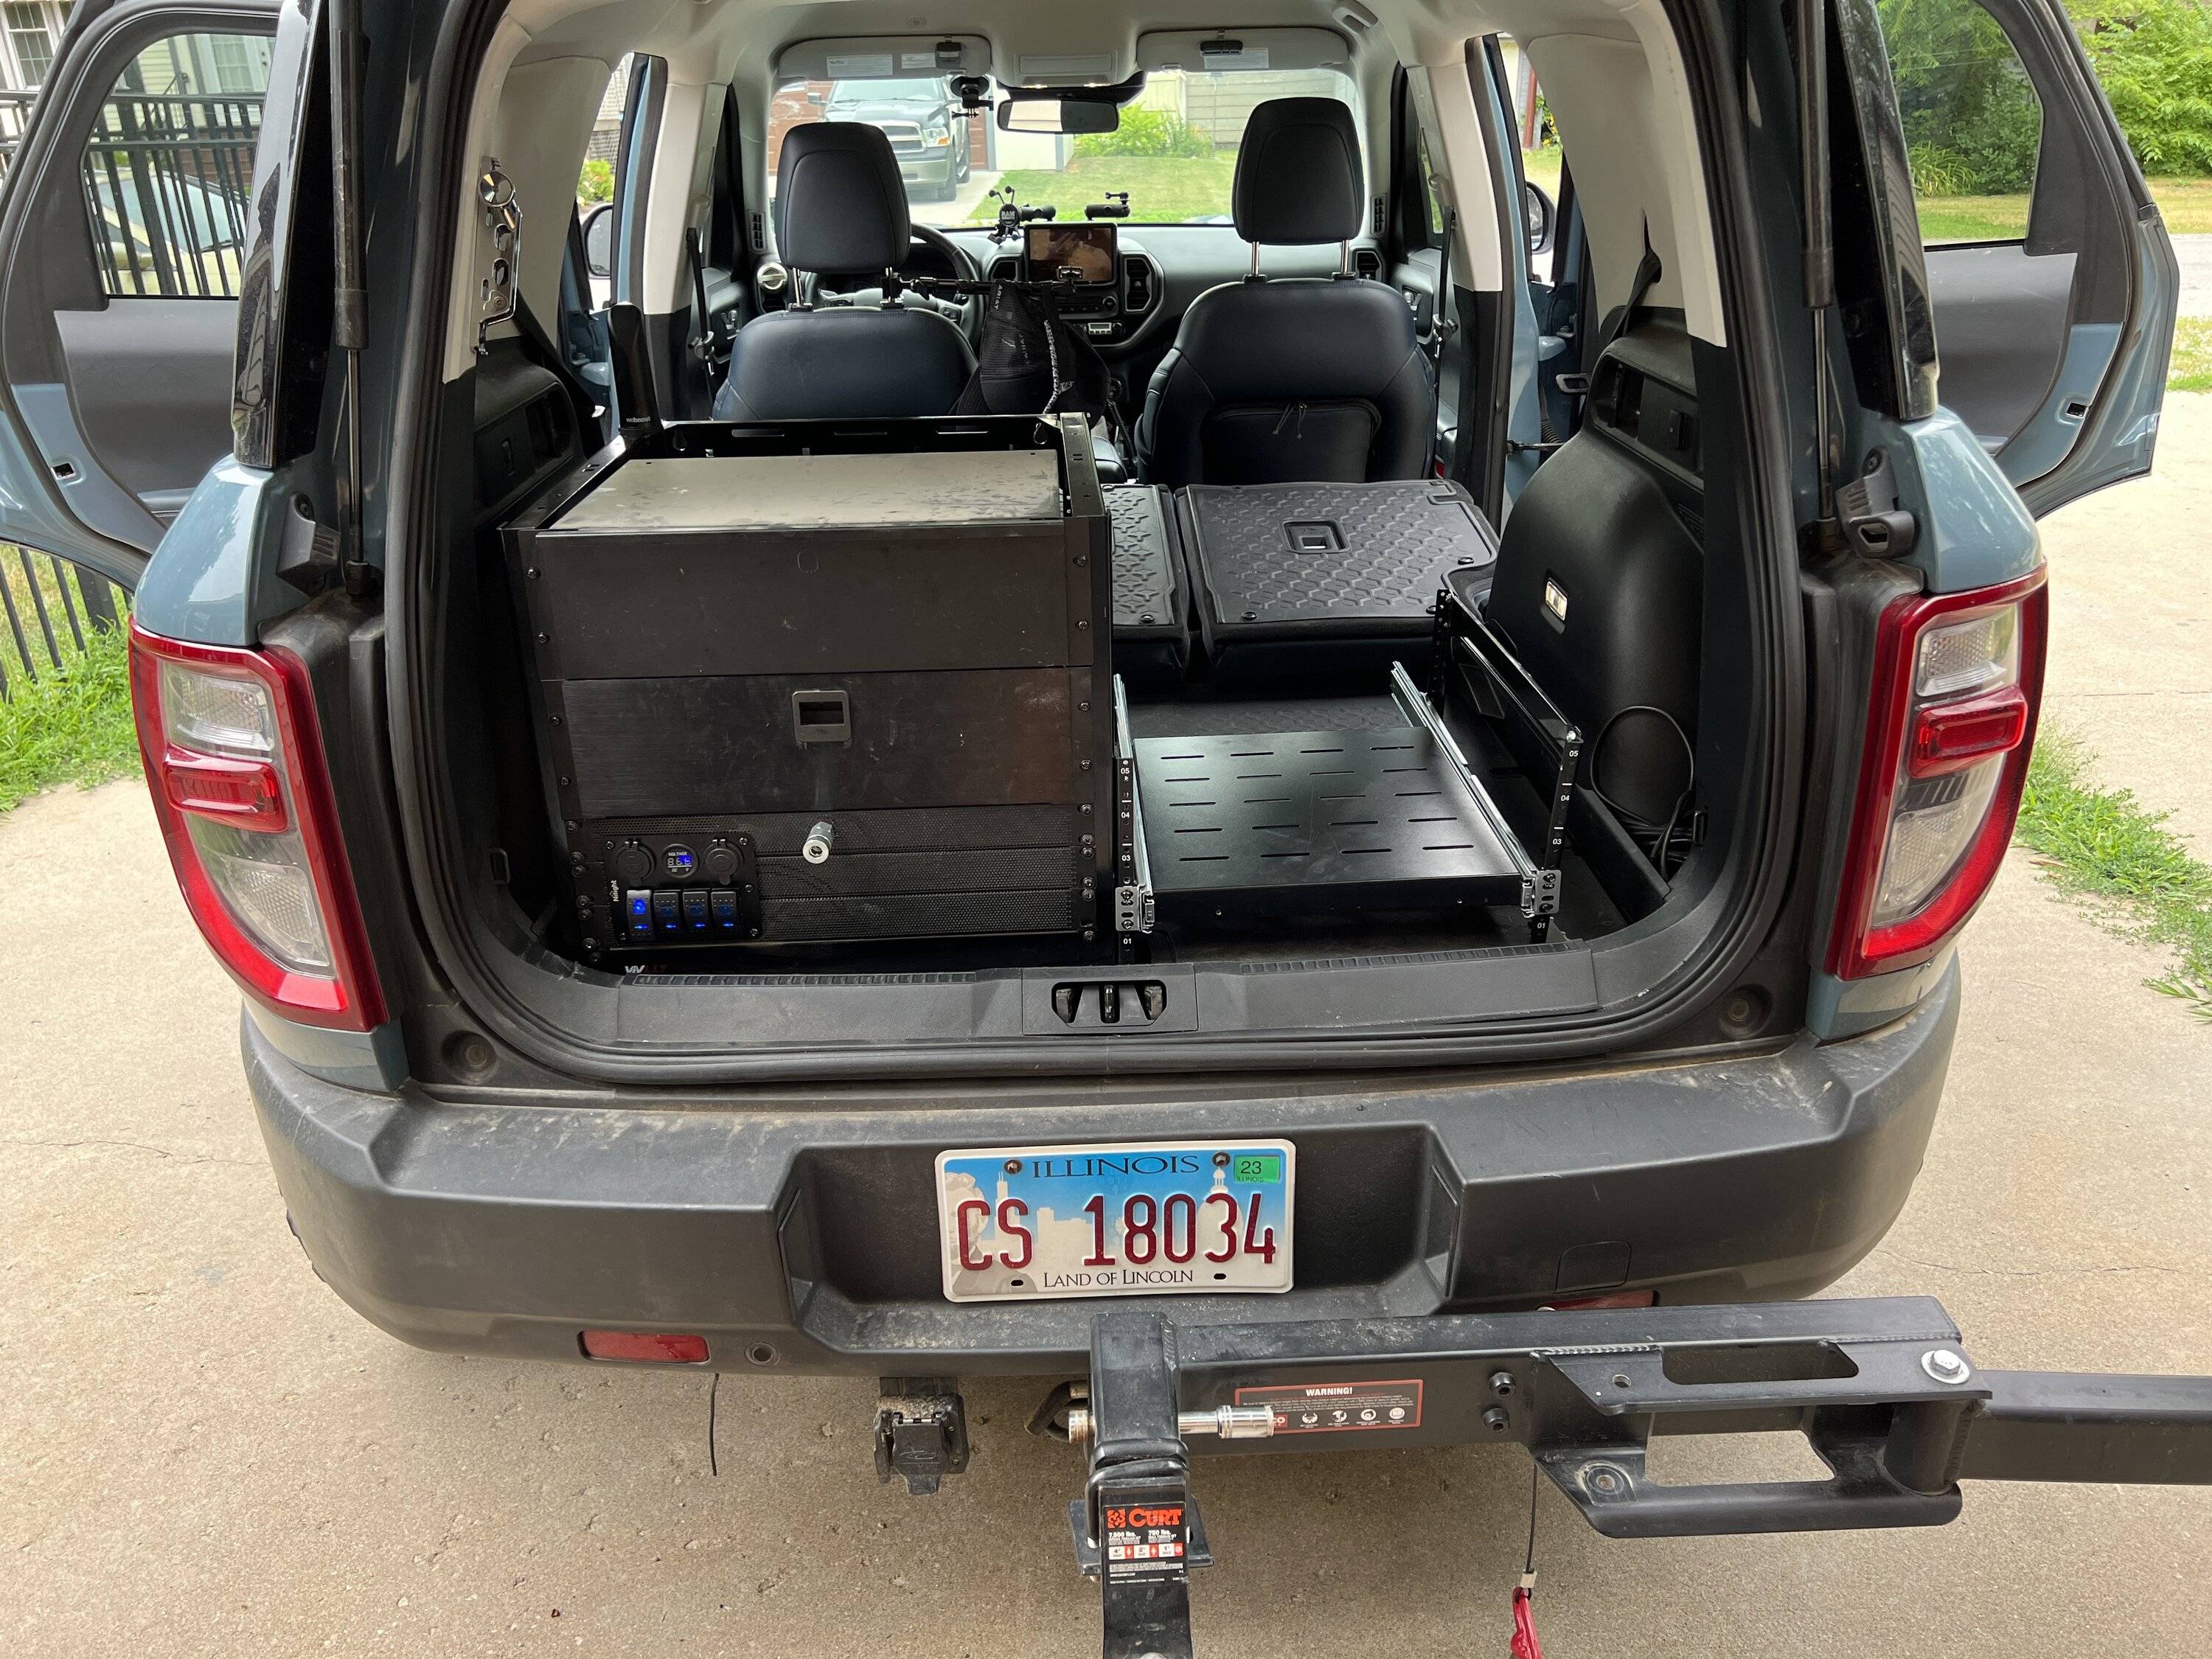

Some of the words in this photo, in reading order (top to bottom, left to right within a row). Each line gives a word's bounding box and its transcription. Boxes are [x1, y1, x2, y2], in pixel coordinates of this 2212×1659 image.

[994, 284, 1003, 310] ARIAT
[1032, 1155, 1200, 1178] ILLINOIS
[1240, 1161, 1262, 1175] 23
[957, 1198, 1032, 1271] CS
[1083, 1193, 1276, 1266] 18034
[1044, 1272, 1092, 1287] LAND
[1096, 1272, 1118, 1285] OF
[1122, 1269, 1194, 1284] LINCOLN
[1305, 1387, 1353, 1397] WARNING!
[1129, 1508, 1182, 1527] CURT
